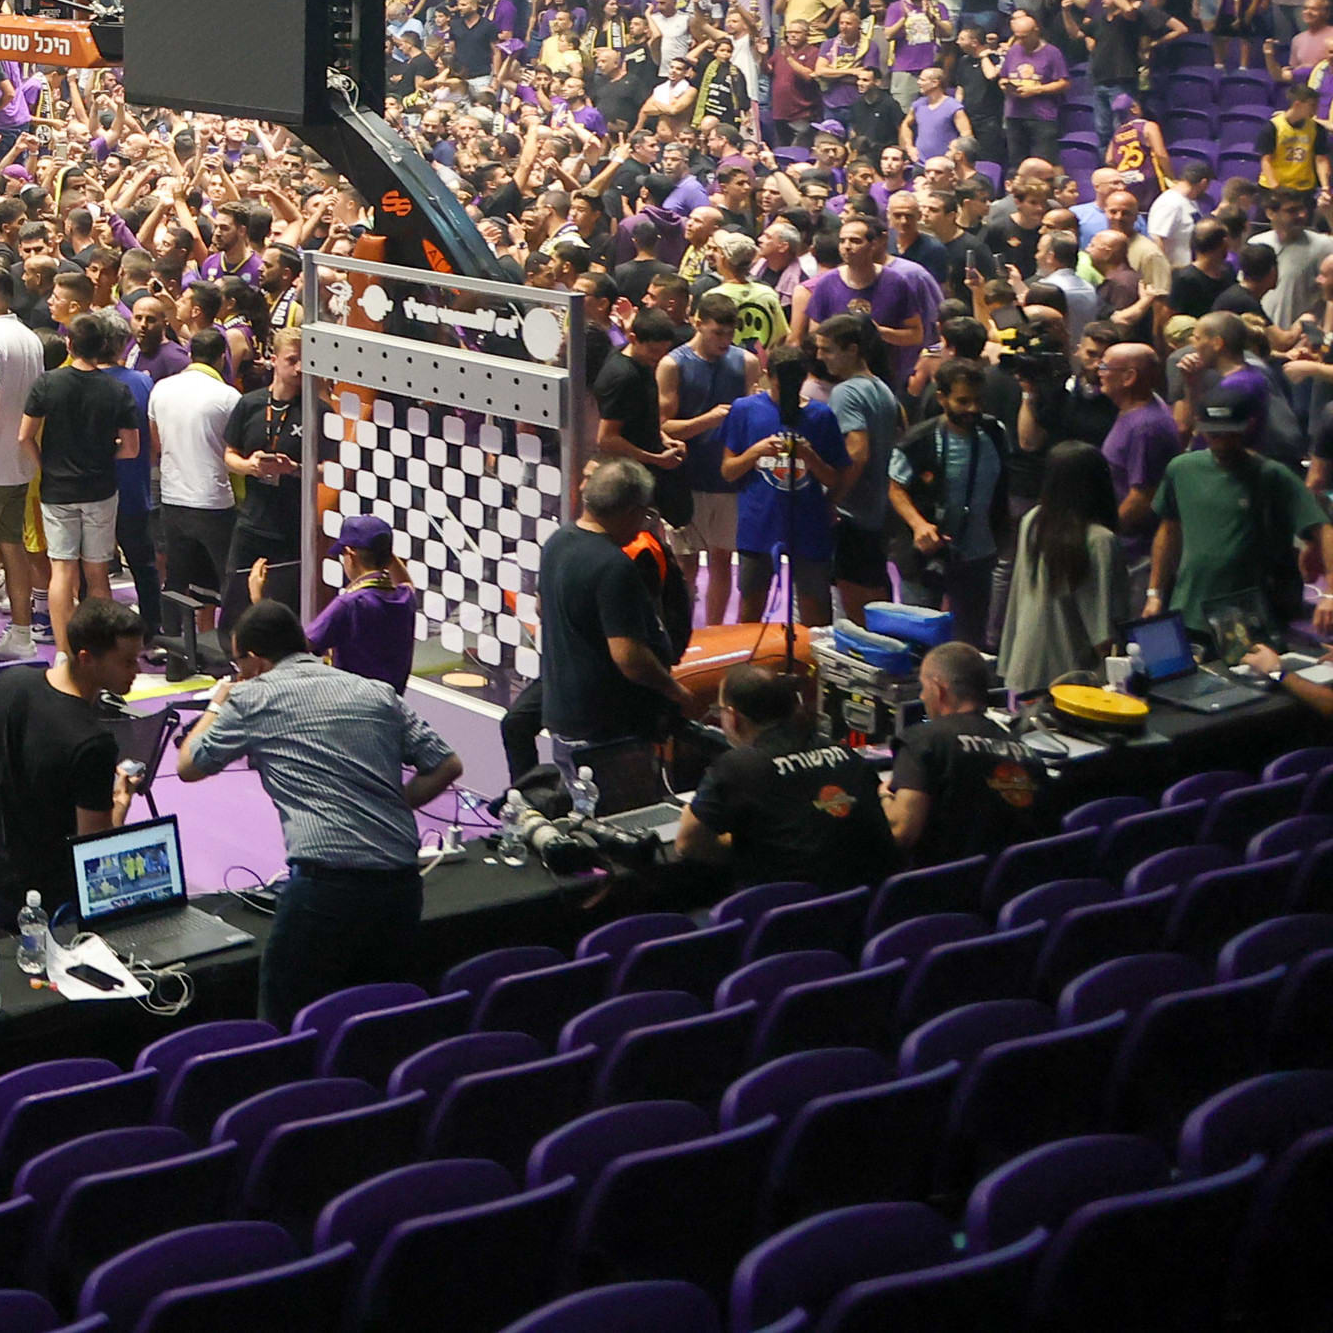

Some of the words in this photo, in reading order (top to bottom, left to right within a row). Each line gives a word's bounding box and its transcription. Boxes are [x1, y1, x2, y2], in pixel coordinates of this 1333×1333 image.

[34, 31, 70, 56] היכל
[1117, 141, 1145, 172] 25
[772, 745, 850, 775] תקשורת
